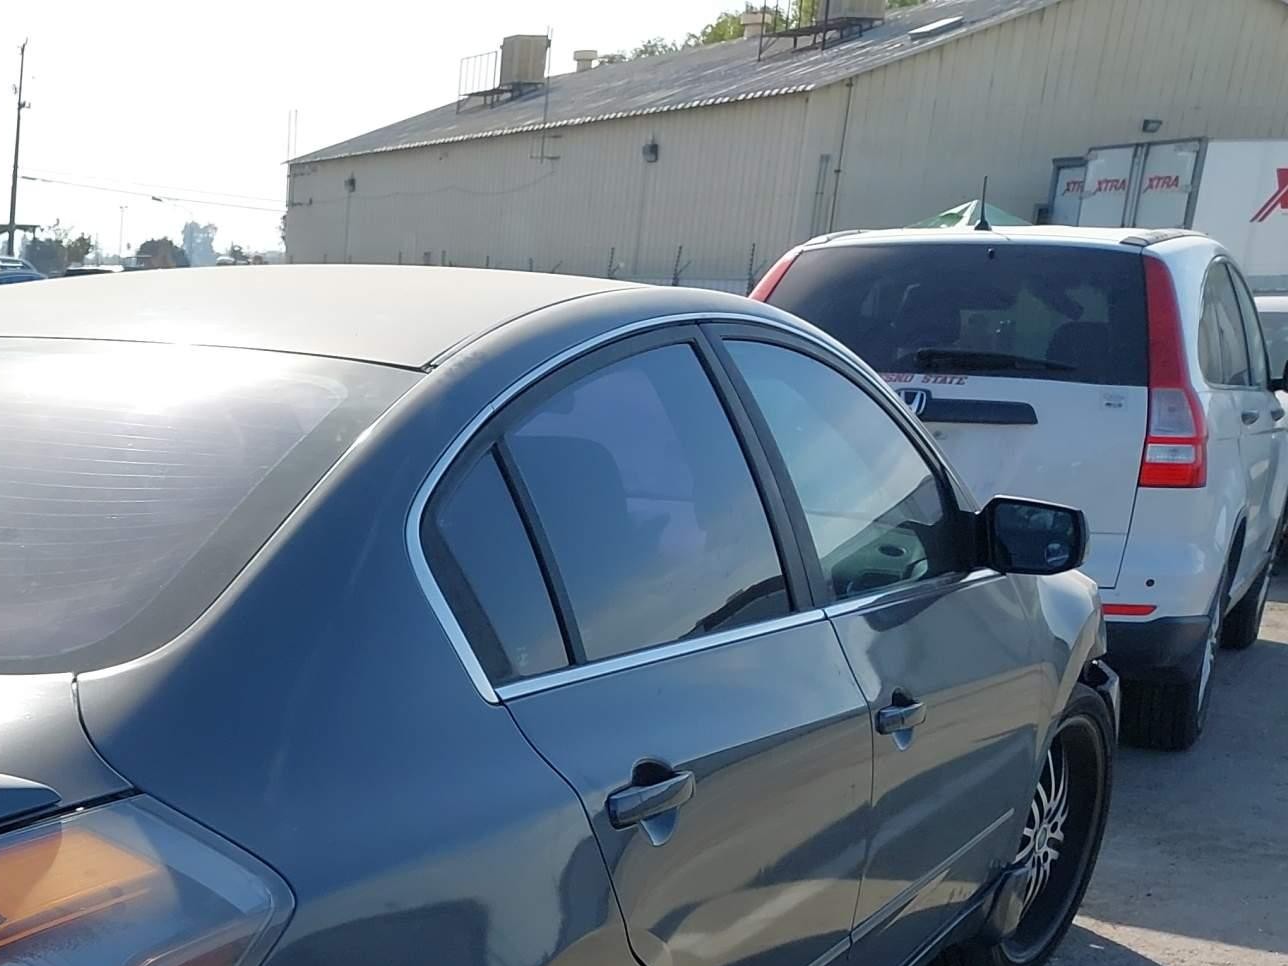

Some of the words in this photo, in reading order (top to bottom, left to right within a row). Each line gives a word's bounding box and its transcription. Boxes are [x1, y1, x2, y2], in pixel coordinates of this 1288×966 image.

[1062, 180, 1085, 196] XTR
[1093, 178, 1127, 195] XTRA
[1143, 175, 1180, 193] XTRA
[921, 374, 968, 386] STATE
